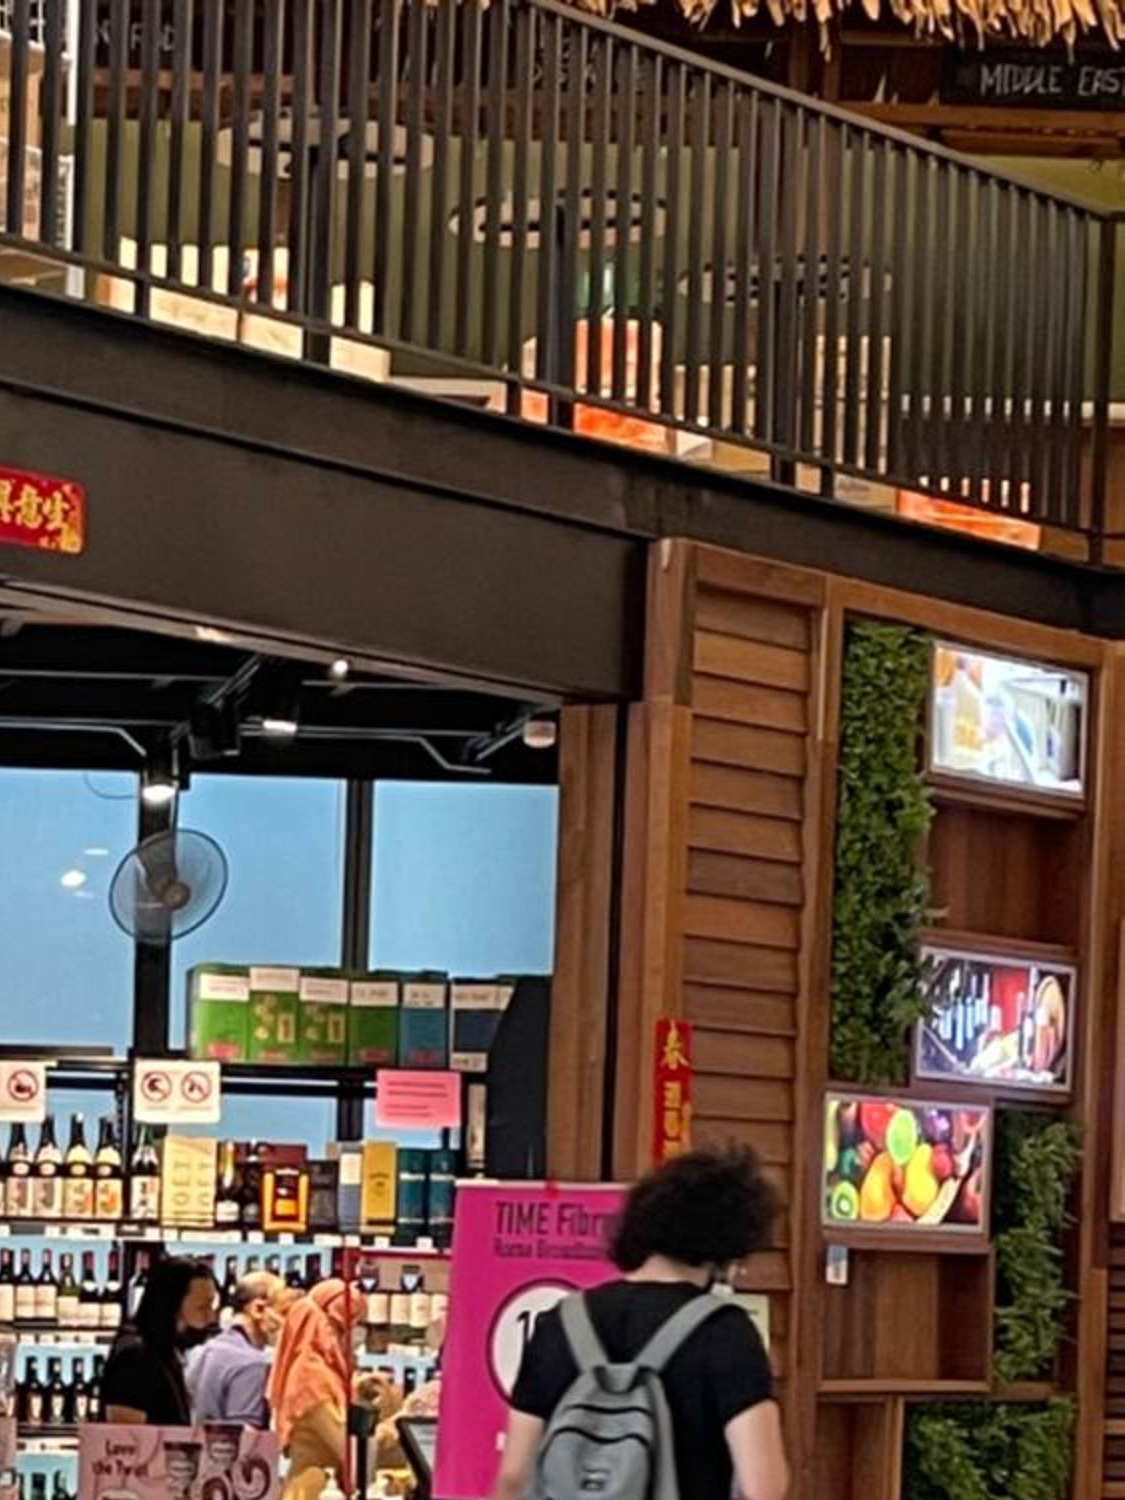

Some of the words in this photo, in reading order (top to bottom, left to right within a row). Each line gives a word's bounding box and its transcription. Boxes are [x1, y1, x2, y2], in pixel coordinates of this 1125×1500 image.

[980, 64, 1062, 96] MIDDLE
[495, 1202, 550, 1235] TIME
[557, 1204, 615, 1236] Fibr
